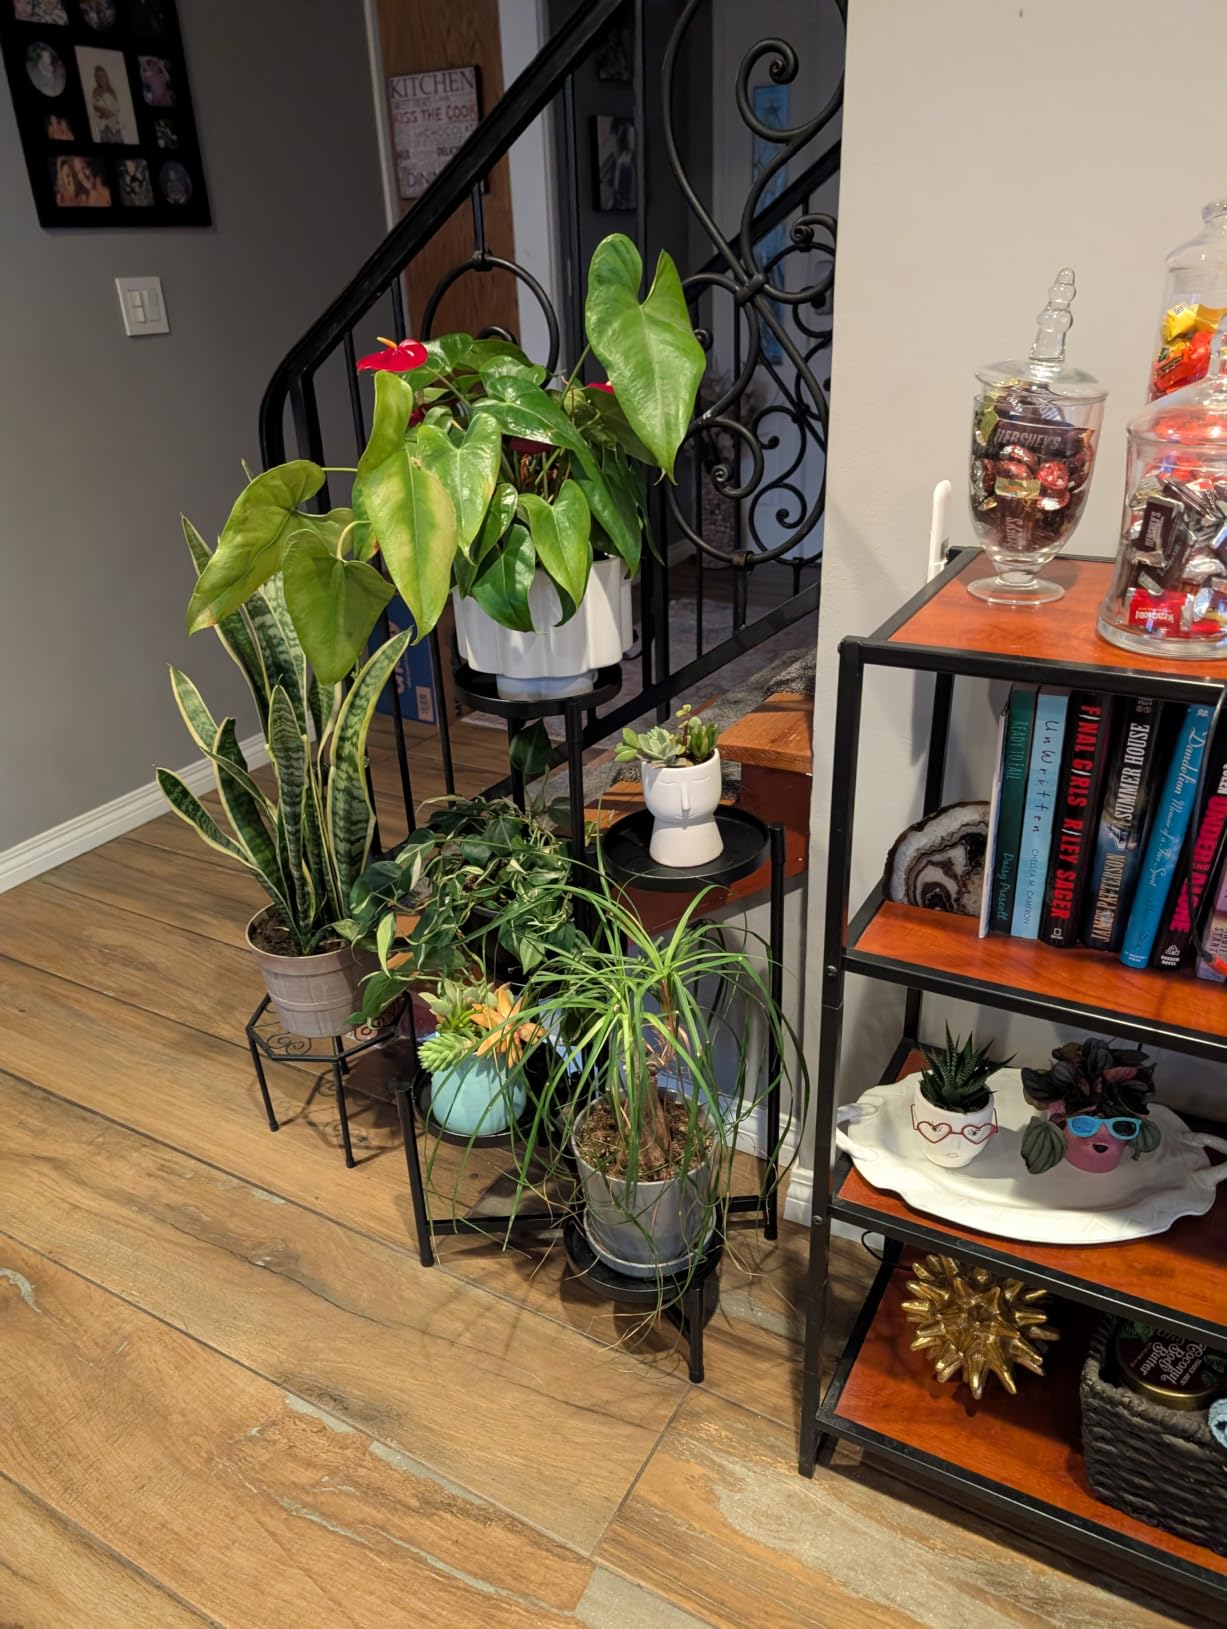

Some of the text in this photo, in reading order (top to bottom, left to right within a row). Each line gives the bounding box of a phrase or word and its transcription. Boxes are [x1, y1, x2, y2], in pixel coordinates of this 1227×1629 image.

[390, 70, 475, 99] KITCHEN
[421, 107, 441, 121] THE
[446, 103, 477, 120] COOK
[994, 428, 1062, 450] HERSHEY'S
[1010, 720, 1028, 748] READY
[1125, 722, 1150, 764] HOUSE
[1174, 728, 1208, 795] Dandelion
[1114, 768, 1141, 820] SUMMER
[1193, 795, 1227, 863] UNDER
[1028, 848, 1040, 878] CHELSEA
[997, 852, 1015, 921] Daisy Prescott
[1051, 870, 1076, 920] SAGER
[1096, 853, 1127, 909] PATTERSON
[1023, 890, 1036, 925] CAMERON
[1090, 909, 1115, 943] JAMES
[1209, 927, 1224, 955] STANT
[1139, 1342, 1169, 1376] Butter
[1159, 1343, 1185, 1372] Body
[1160, 1343, 1206, 1384] Coconut
